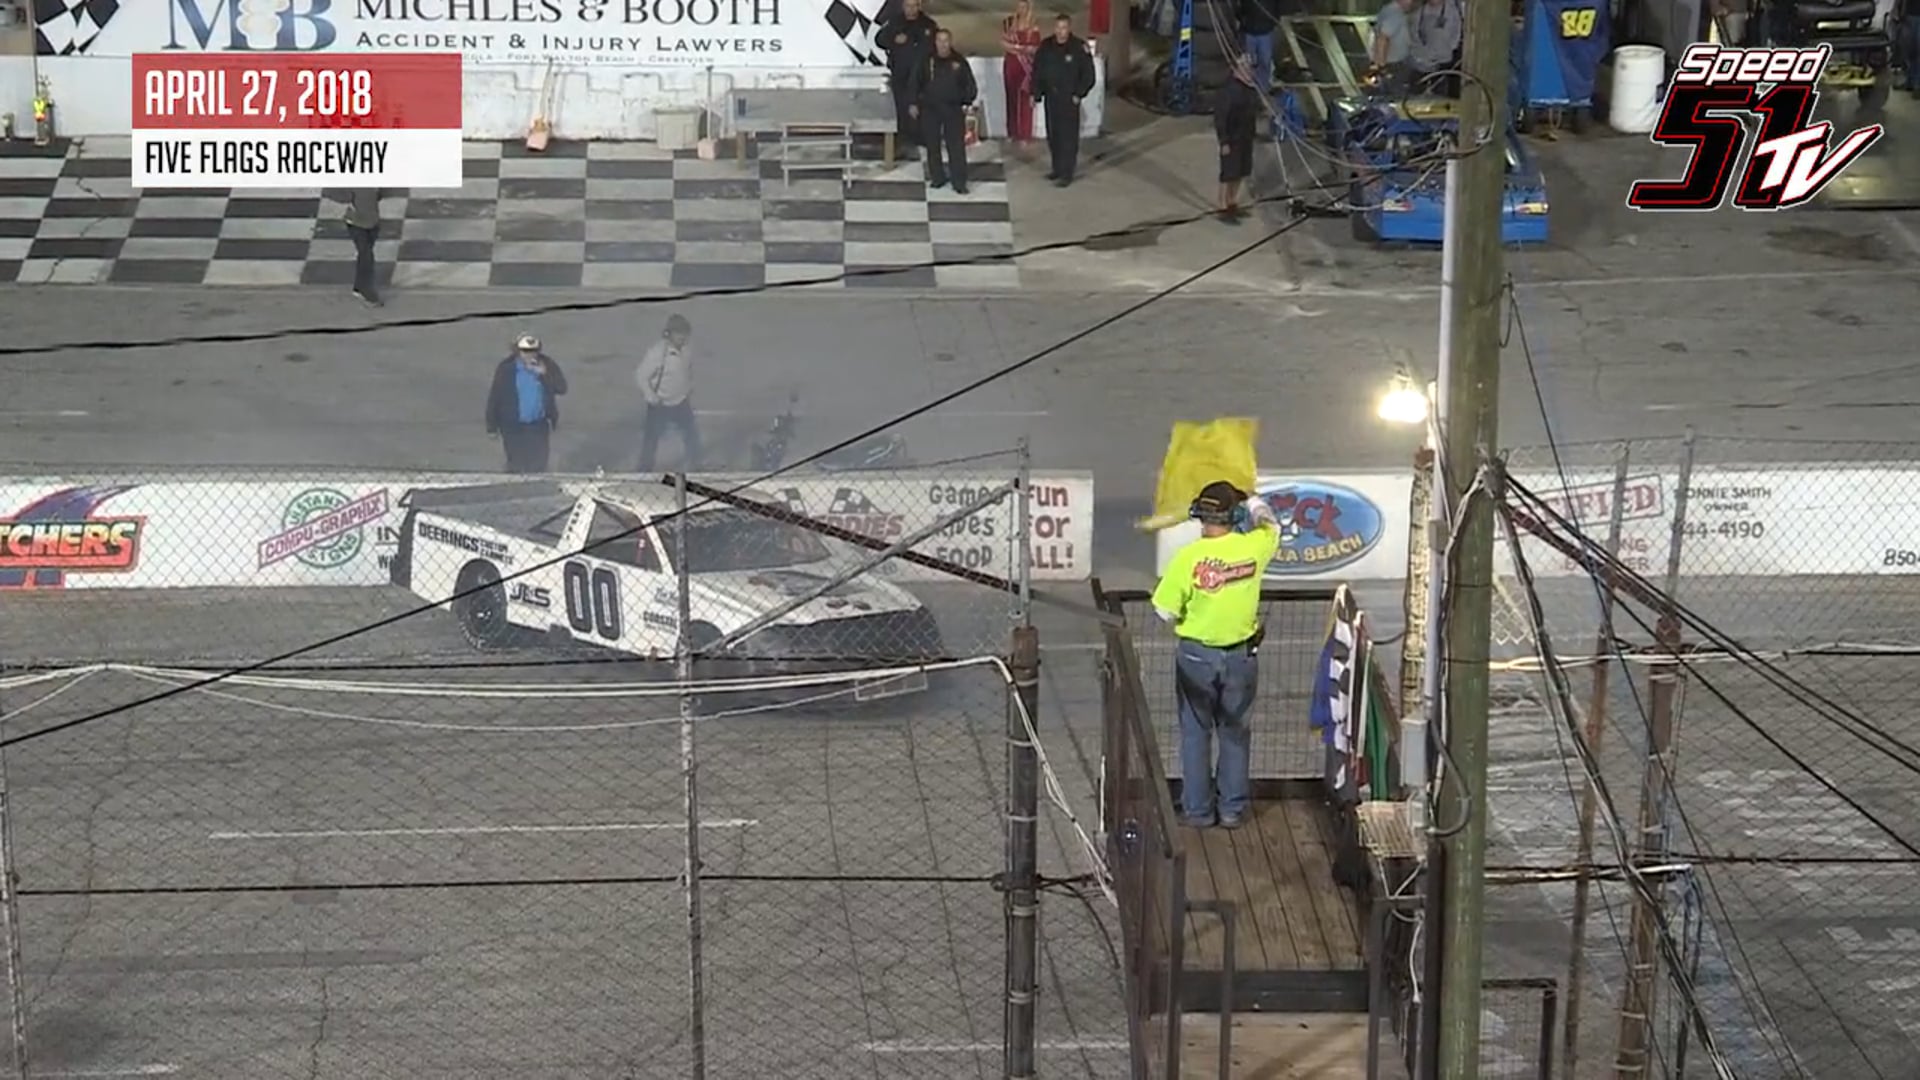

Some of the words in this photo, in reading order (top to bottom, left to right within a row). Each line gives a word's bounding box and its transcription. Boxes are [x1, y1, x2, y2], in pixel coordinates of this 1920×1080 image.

[354, 0, 562, 23] MICHLES
[577, 0, 607, 22] &
[622, 0, 783, 26] BOOTH
[356, 32, 495, 49] ACCIDENT
[508, 34, 526, 49] &
[543, 34, 641, 51] INJURY
[656, 36, 783, 52] LAWYERS
[1732, 487, 1771, 499] SMITH
[264, 496, 383, 559] COMPU-GRAPHIX
[1028, 514, 1070, 539] or
[1303, 533, 1363, 562] BEACH
[563, 560, 621, 641] 00
